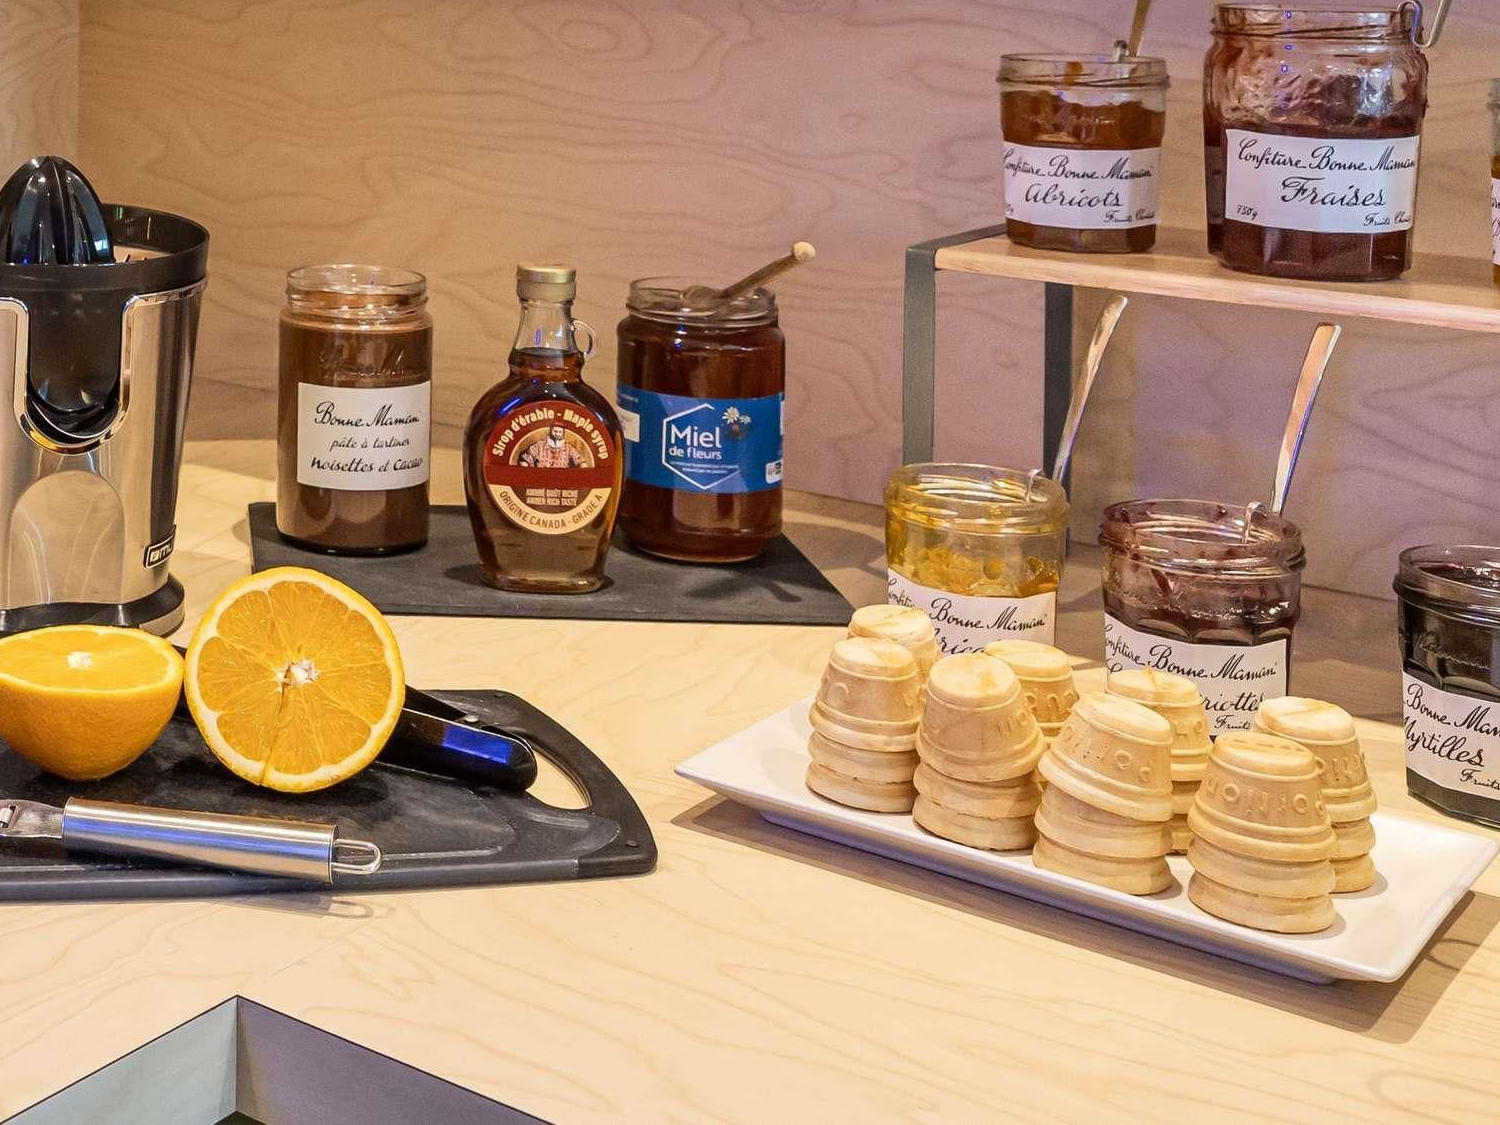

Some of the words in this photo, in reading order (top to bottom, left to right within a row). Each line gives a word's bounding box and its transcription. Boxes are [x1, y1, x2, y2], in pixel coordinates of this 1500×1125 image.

[1047, 154, 1100, 180] Bonne
[1101, 156, 1152, 180] Maman
[1238, 137, 1307, 170] Confiture
[1308, 145, 1368, 171] Bonne
[1369, 145, 1415, 172] Maman
[1280, 176, 1387, 207] Fraises
[314, 401, 364, 428] Bonne
[366, 403, 420, 427] Maman
[492, 430, 514, 457] Sirop
[511, 408, 555, 432] d'érable
[563, 409, 594, 432] Maple
[591, 430, 609, 460] syrup
[670, 424, 722, 448] Miel
[668, 446, 684, 457] de
[687, 446, 722, 460] fleurs
[499, 491, 528, 521] ORIGINE
[529, 515, 567, 529] CANADA
[572, 502, 598, 524] GRADE
[929, 597, 984, 629] Bonne
[986, 606, 1045, 631] Maman
[1147, 644, 1208, 679] Bonne
[1210, 653, 1274, 682] Maman
[1406, 683, 1451, 726] Bonne
